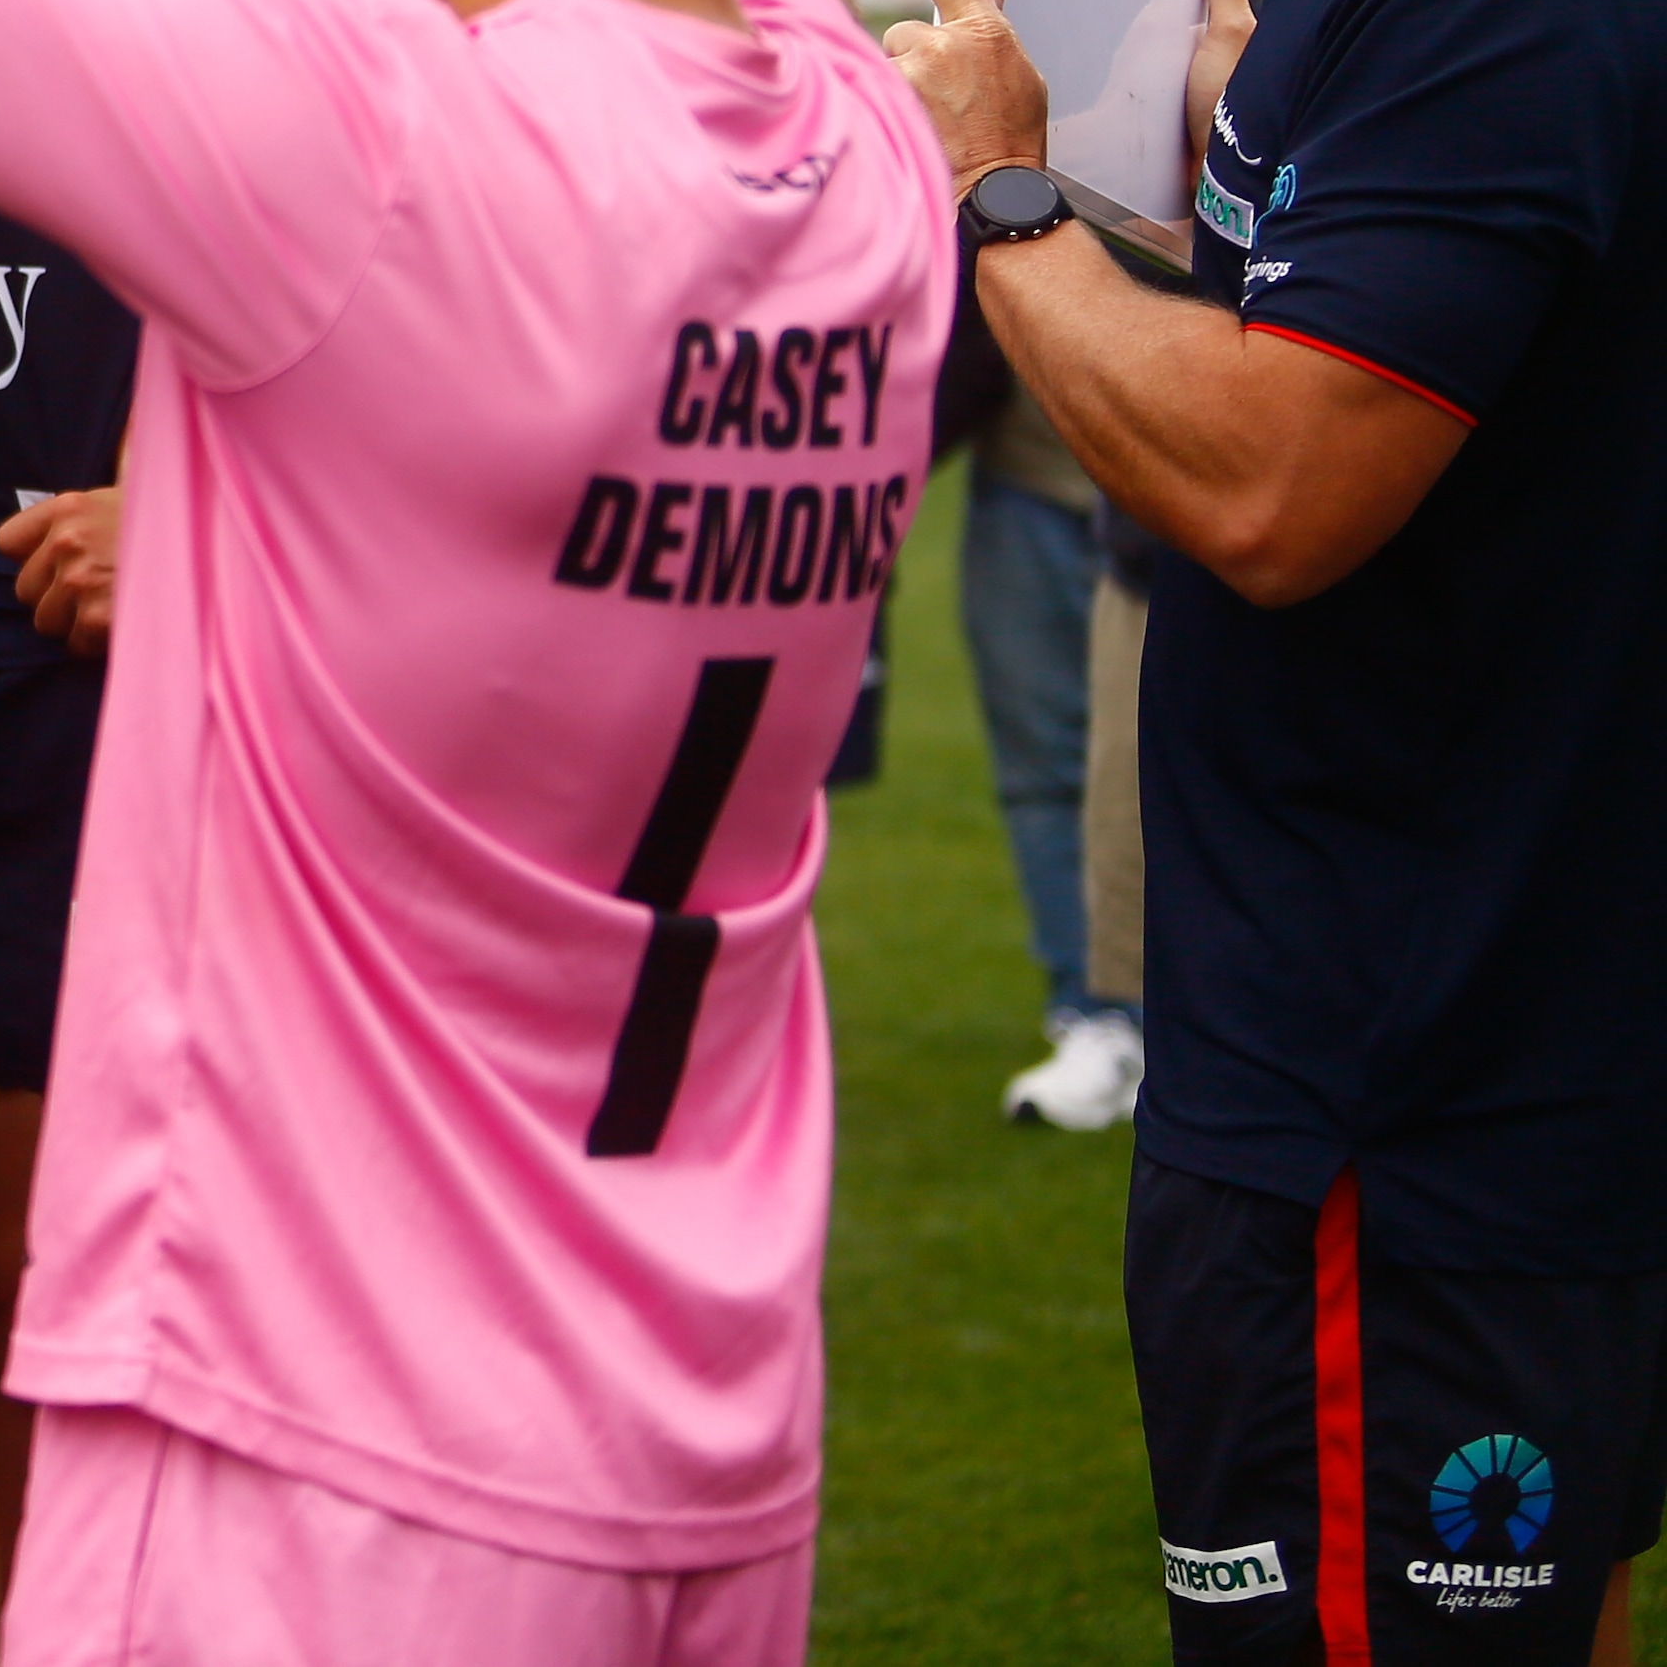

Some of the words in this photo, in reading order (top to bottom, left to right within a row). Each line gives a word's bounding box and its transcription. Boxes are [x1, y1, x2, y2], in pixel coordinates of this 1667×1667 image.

[657, 321, 893, 454] CASEY
[550, 474, 909, 608] DEMONS
[1405, 1559, 1555, 1588] CARLISLE
[1436, 1586, 1476, 1613] Life's
[1478, 1592, 1521, 1609] better
